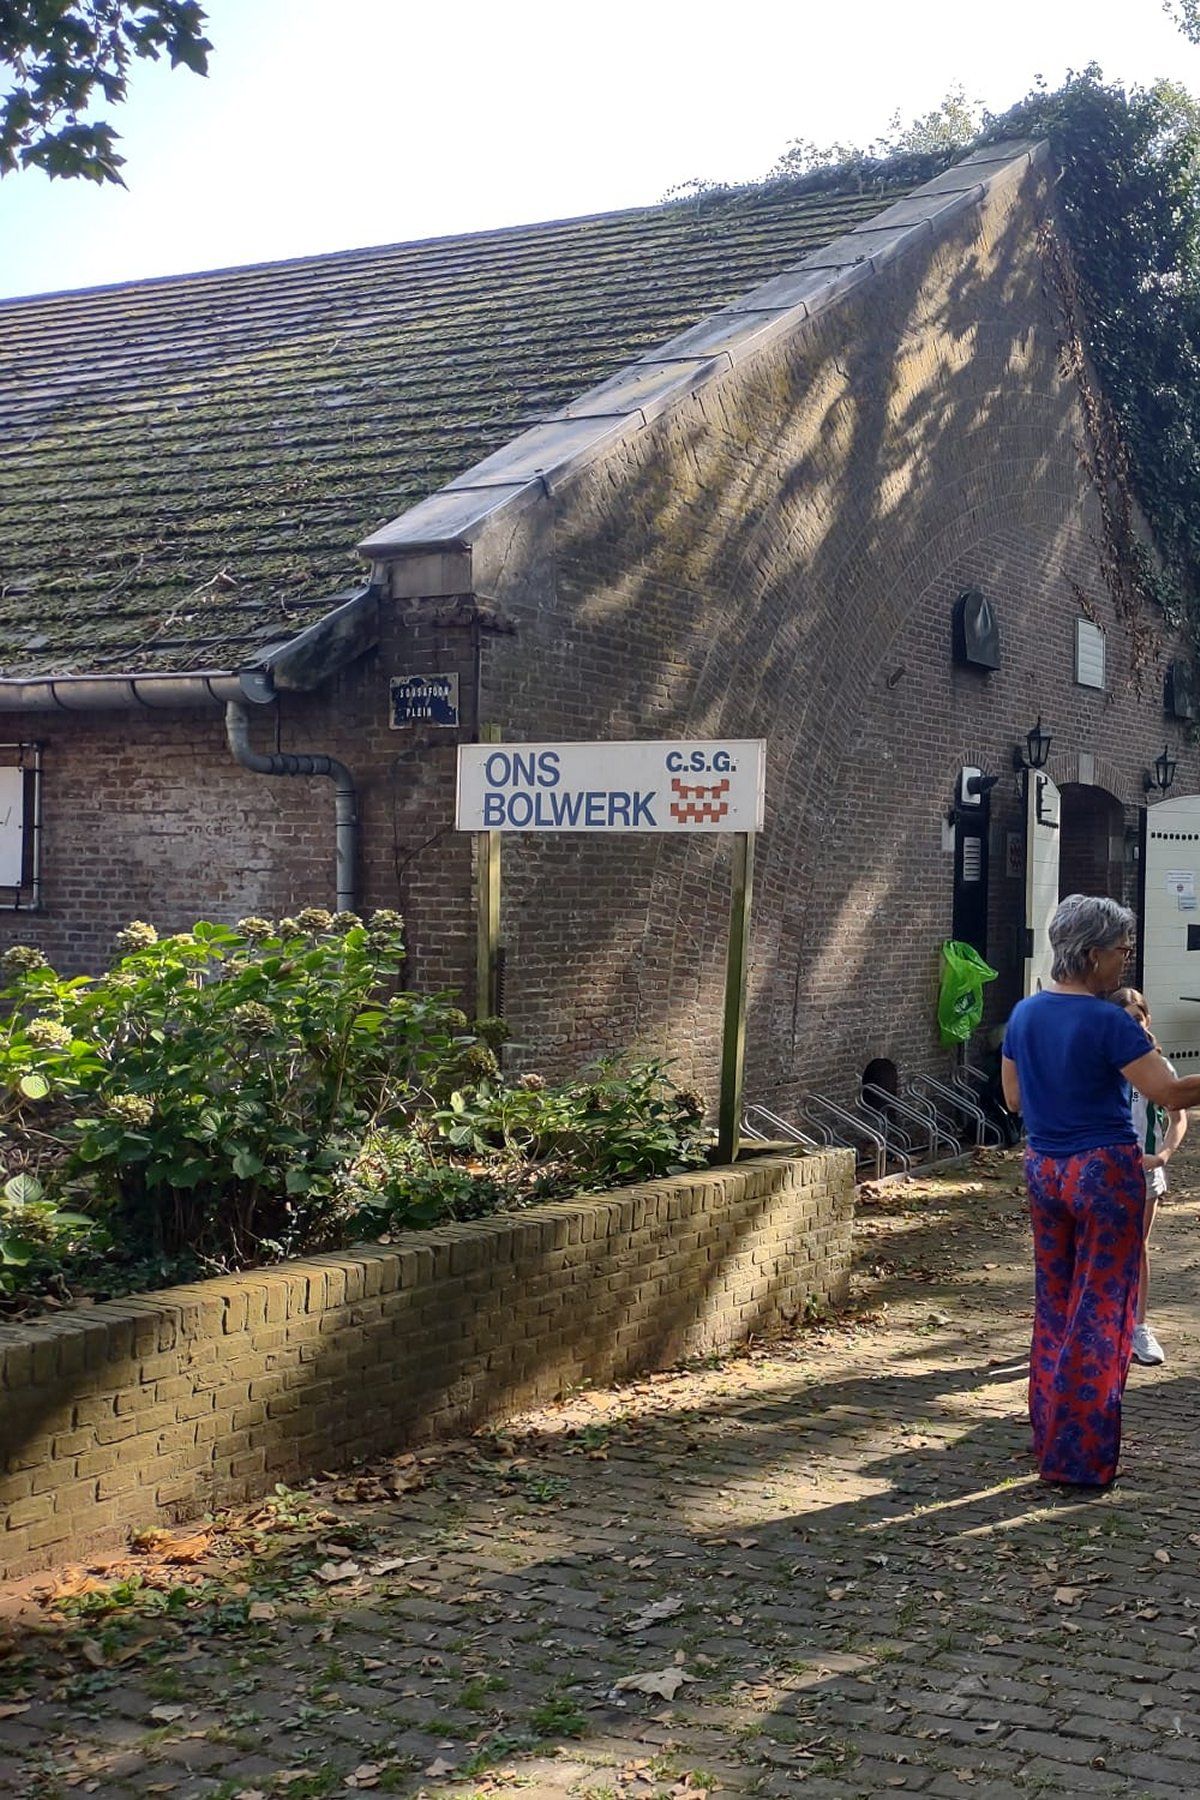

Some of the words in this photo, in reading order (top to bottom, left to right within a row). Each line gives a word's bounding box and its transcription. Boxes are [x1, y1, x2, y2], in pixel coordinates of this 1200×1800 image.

[406, 706, 432, 717] PLEIN
[485, 751, 560, 787] ONS
[665, 751, 737, 772] C.S.G.
[483, 791, 658, 827] BOLWERK
